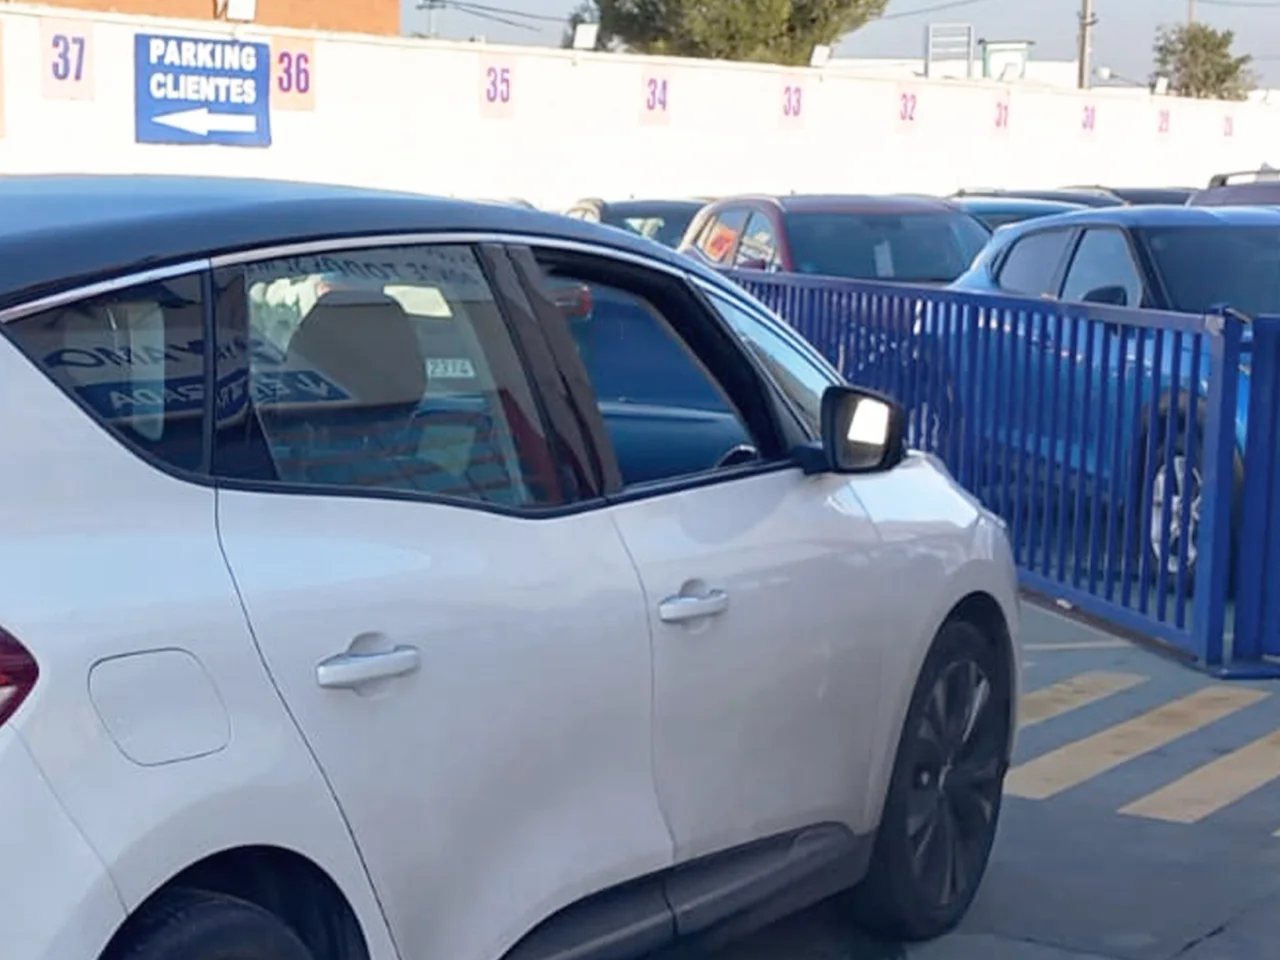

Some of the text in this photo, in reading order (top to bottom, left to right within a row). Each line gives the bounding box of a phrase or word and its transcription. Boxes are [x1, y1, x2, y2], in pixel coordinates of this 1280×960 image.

[52, 35, 85, 81] 37
[149, 38, 257, 71] PARKING
[278, 52, 310, 93] 36
[486, 67, 510, 102] 35
[150, 74, 257, 104] CLIENTES
[646, 79, 668, 111] 34
[784, 87, 802, 117] 33
[900, 93, 917, 121] 32
[995, 102, 1008, 128] 31
